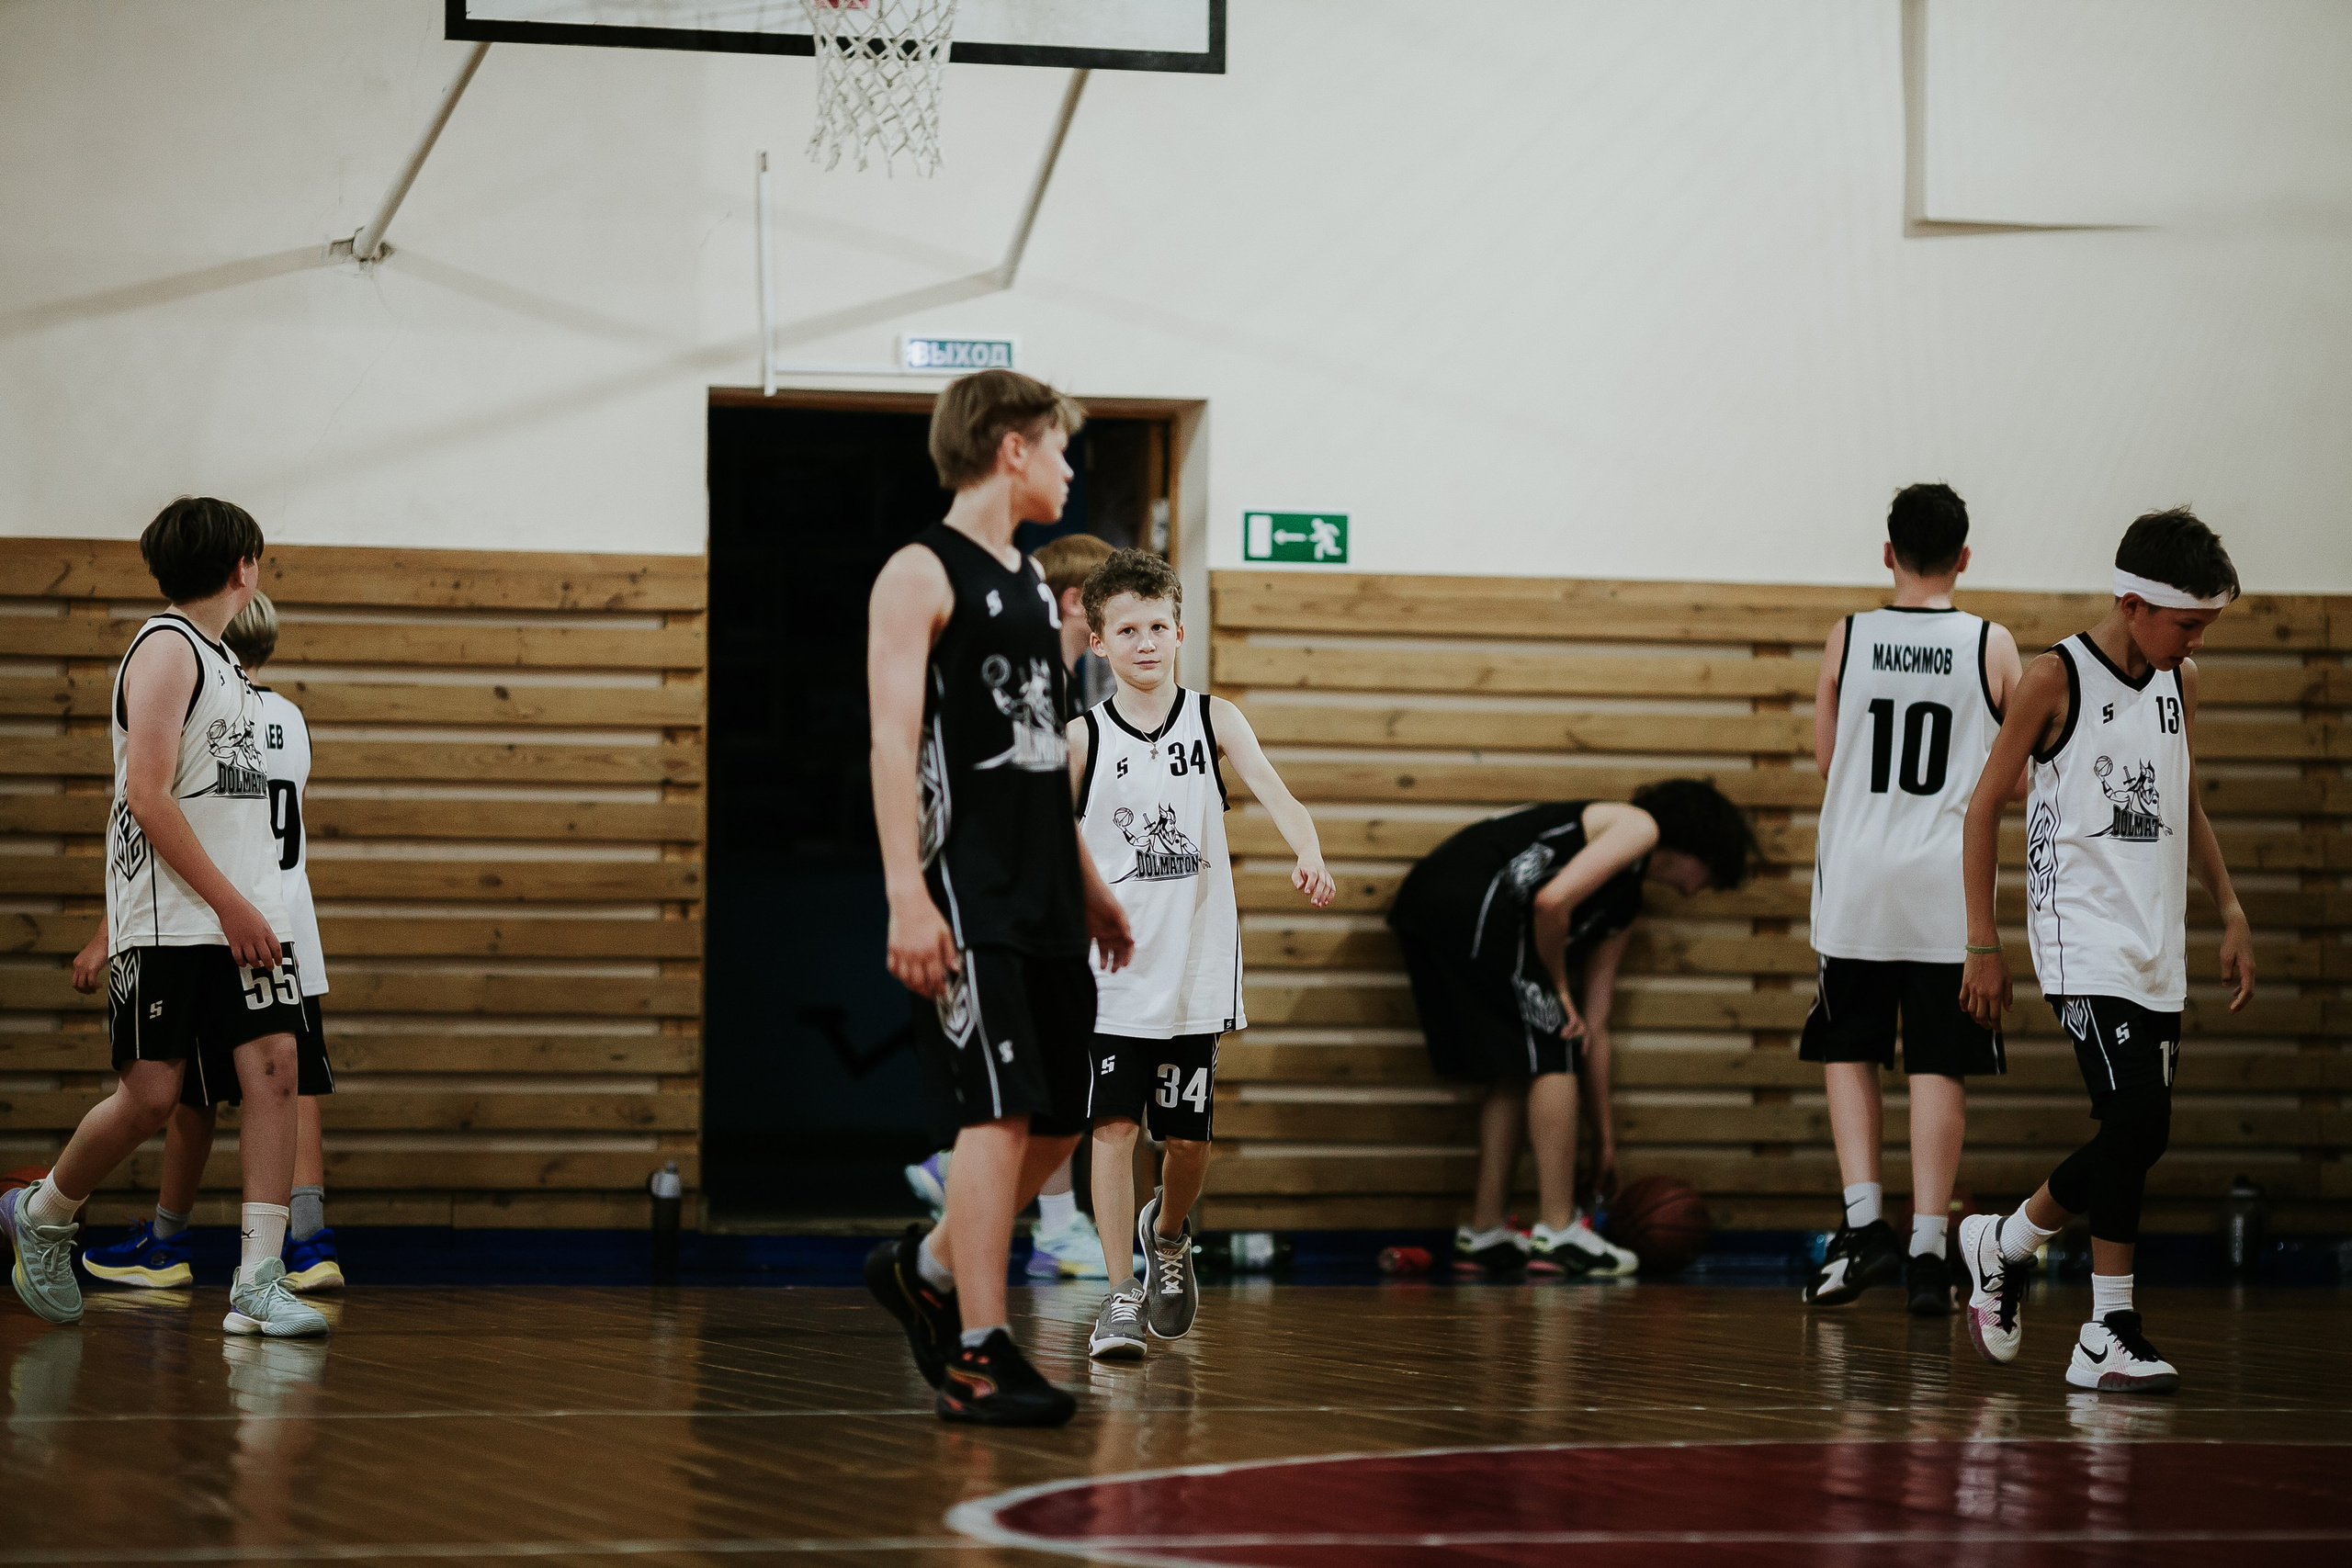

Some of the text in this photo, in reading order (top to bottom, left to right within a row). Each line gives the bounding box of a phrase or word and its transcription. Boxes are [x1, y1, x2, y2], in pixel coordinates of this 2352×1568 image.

[909, 341, 1010, 367] ВЫХОД
[1872, 642, 1953, 675] МАКСИМОВ
[2155, 695, 2181, 735] 13
[264, 723, 284, 750] ЕВ
[1868, 698, 1953, 796] 10
[1167, 739, 1207, 777] 34
[267, 779, 301, 871] 9
[1135, 848, 1200, 878] DOLMATON
[239, 957, 300, 1010] 55
[1155, 1063, 1209, 1113] 34
